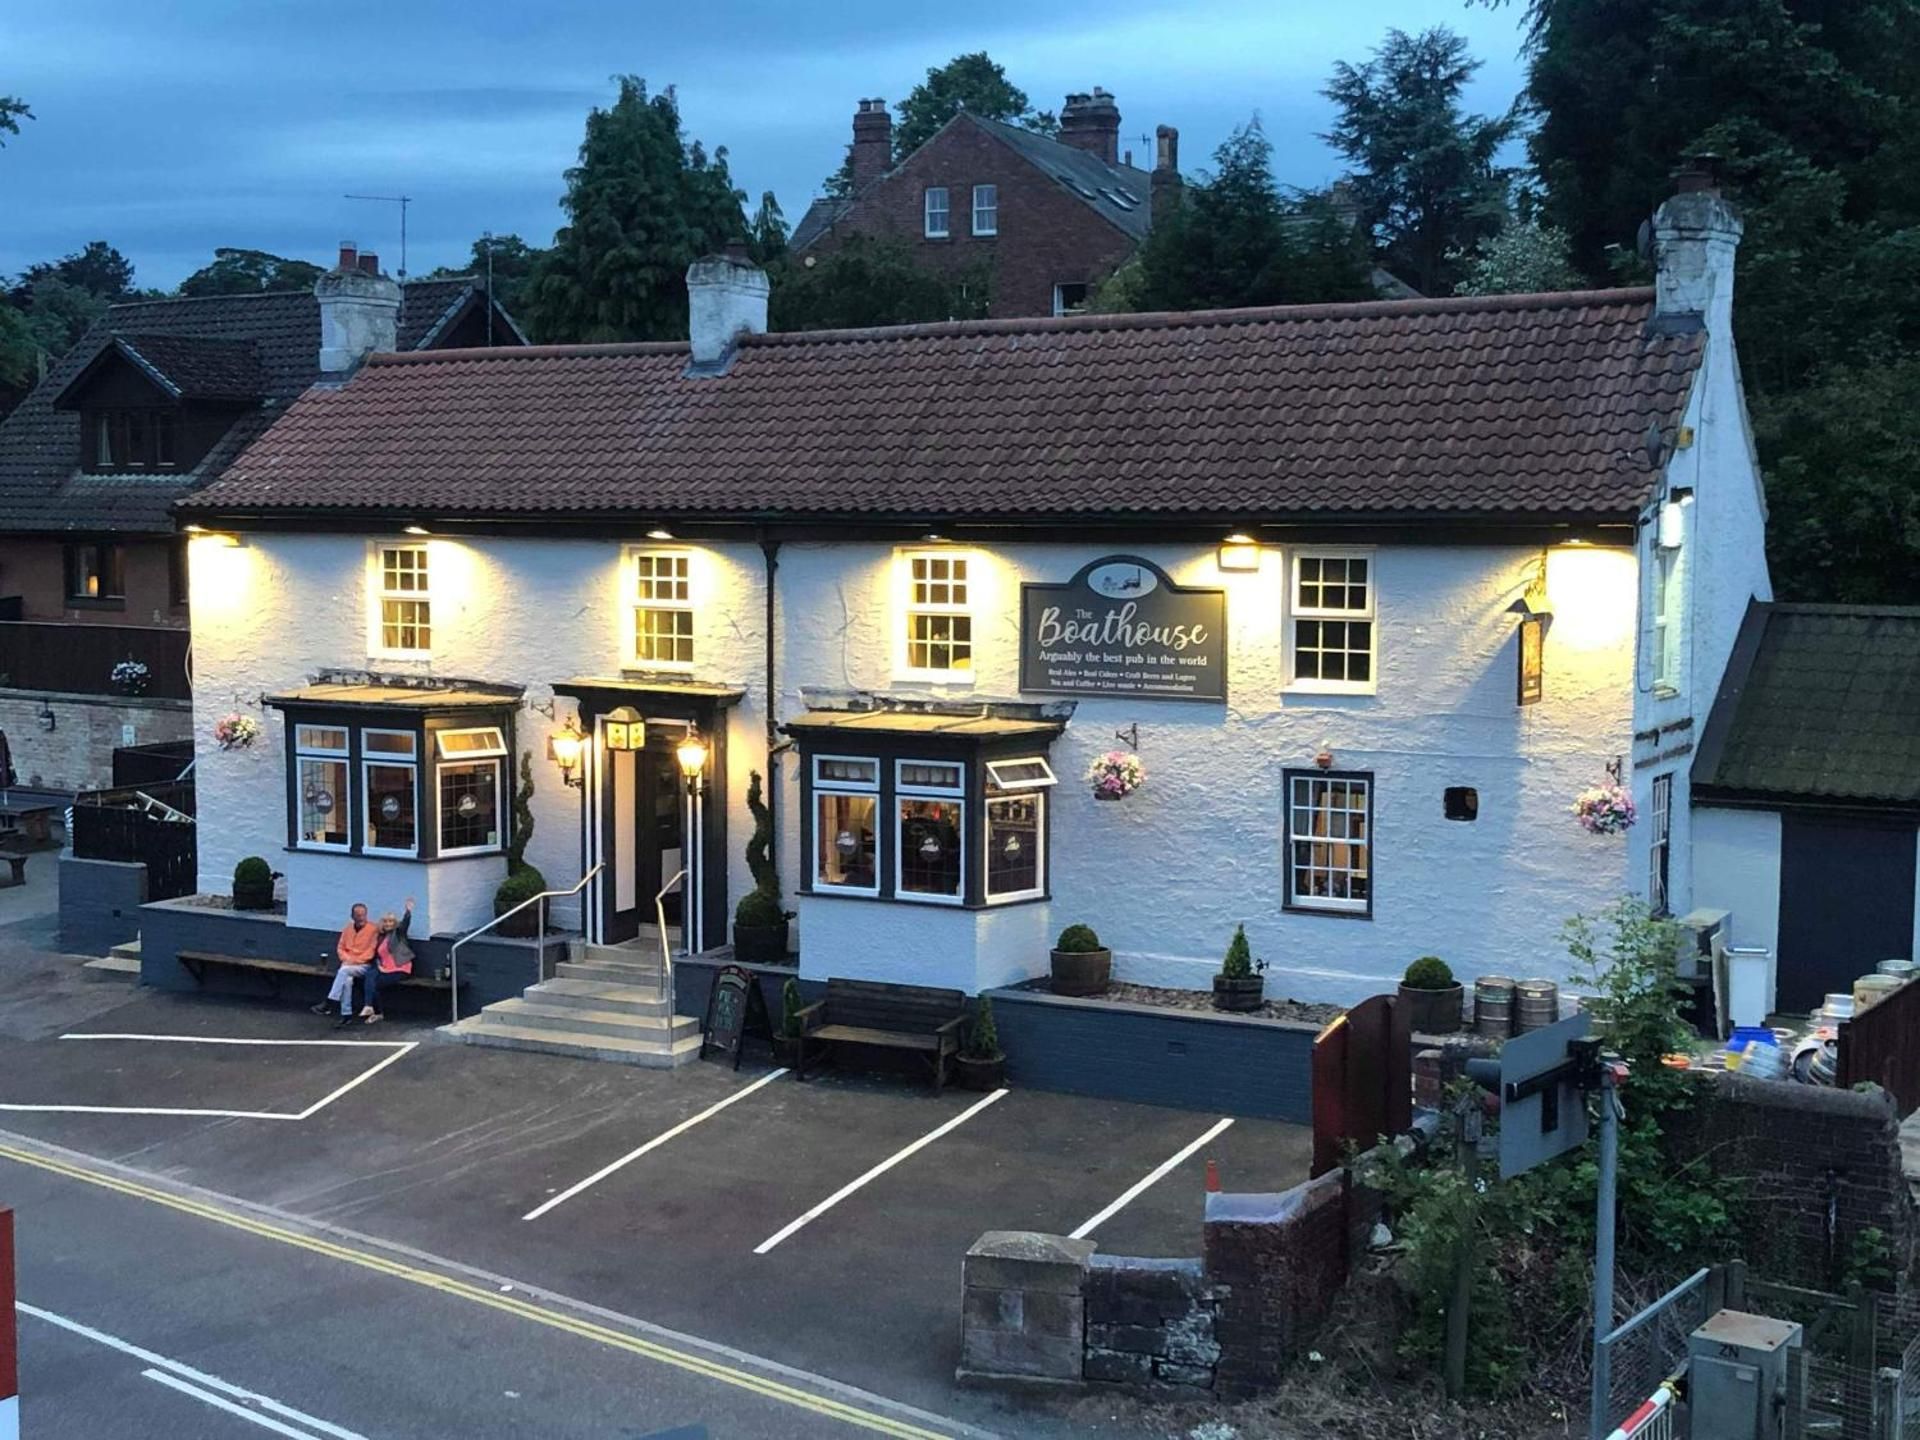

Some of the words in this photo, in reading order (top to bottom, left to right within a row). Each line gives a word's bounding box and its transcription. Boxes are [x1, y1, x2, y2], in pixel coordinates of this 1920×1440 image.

[1075, 608, 1092, 619] The
[1038, 602, 1208, 651] Boathouse
[1039, 651, 1082, 664] Arguably
[1086, 652, 1101, 663] the
[1103, 653, 1122, 664] best
[1125, 655, 1144, 666] pub
[1147, 655, 1157, 664] in
[1160, 655, 1175, 665] the
[1179, 656, 1207, 666] world
